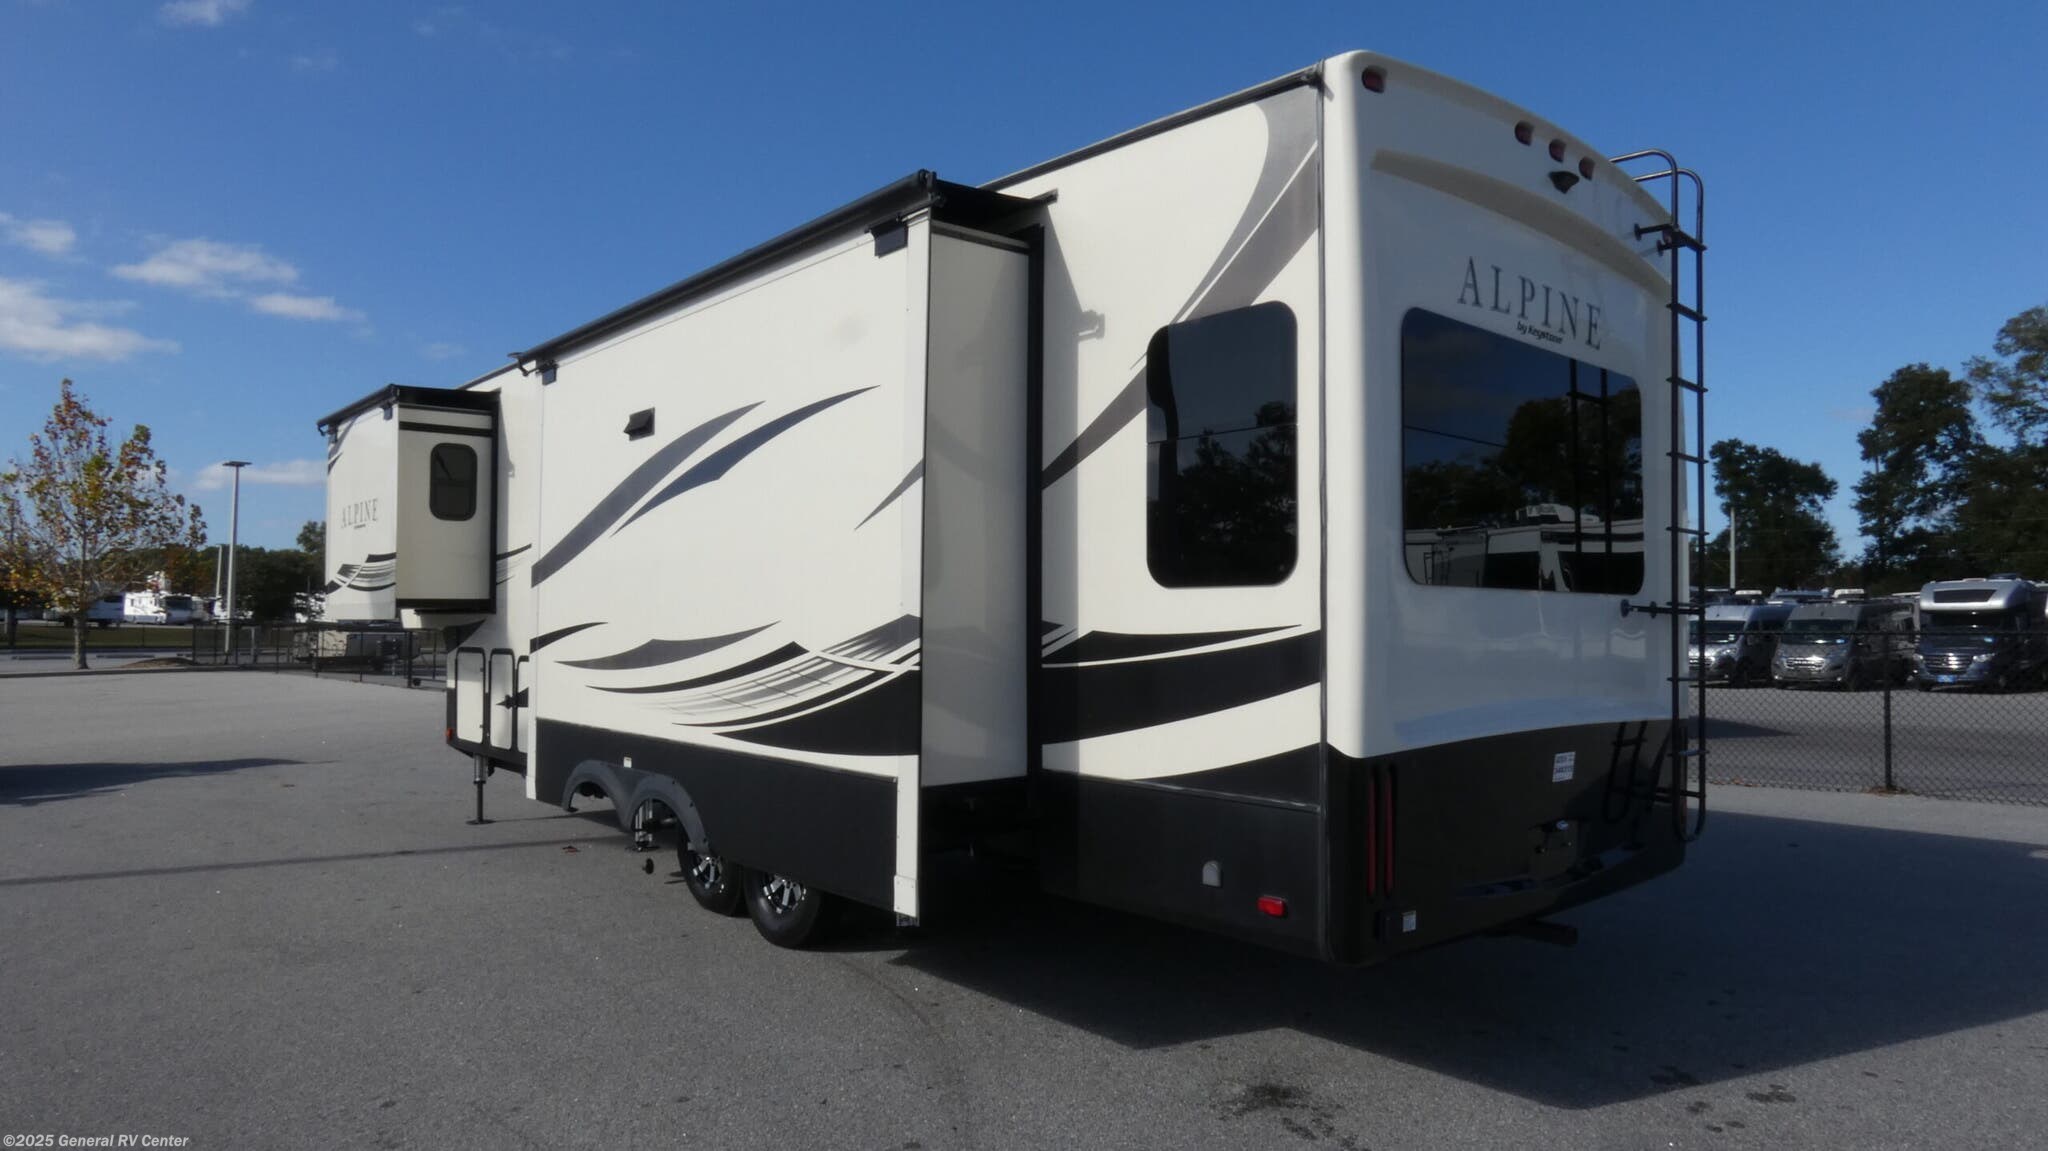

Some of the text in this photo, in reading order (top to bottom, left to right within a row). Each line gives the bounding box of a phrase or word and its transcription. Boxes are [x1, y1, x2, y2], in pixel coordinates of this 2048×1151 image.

[1457, 255, 1601, 350] ALPINE
[1517, 321, 1527, 335] by
[340, 498, 378, 528] ALPINE
